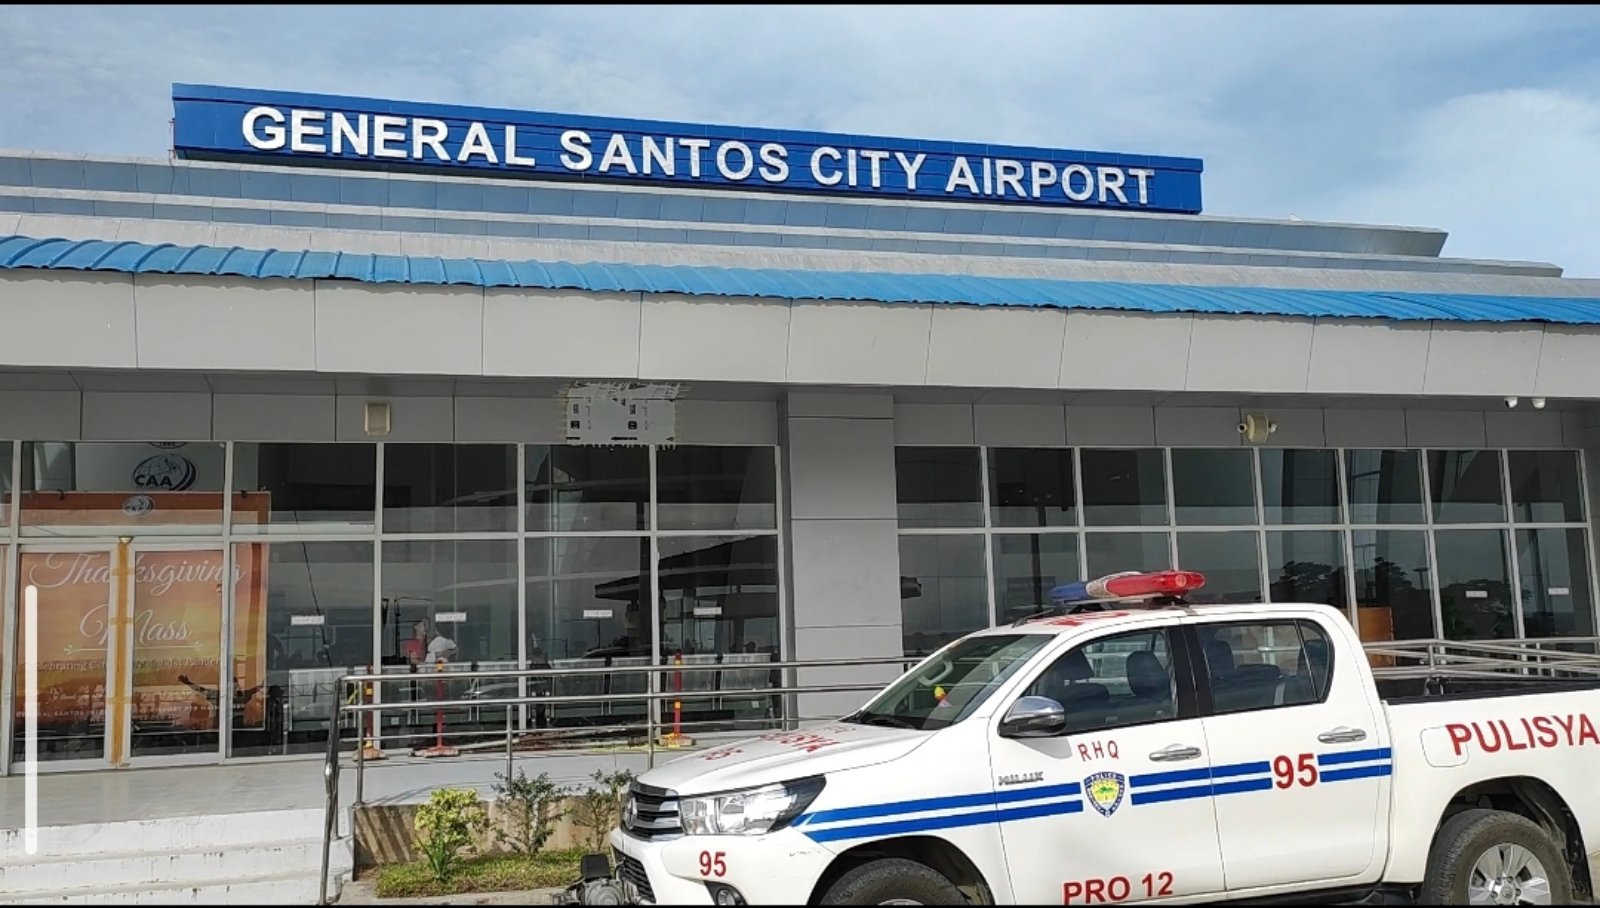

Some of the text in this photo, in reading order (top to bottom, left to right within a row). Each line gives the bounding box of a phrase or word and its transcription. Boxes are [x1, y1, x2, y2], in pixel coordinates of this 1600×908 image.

[242, 106, 1155, 205] GENERAL SANTOS CITY AIRPORT
[1077, 740, 1119, 761] RHQ
[1445, 714, 1600, 756] PULISYA
[1273, 753, 1318, 789] 95
[699, 851, 727, 878] 95
[1063, 871, 1173, 906] PRO 12
